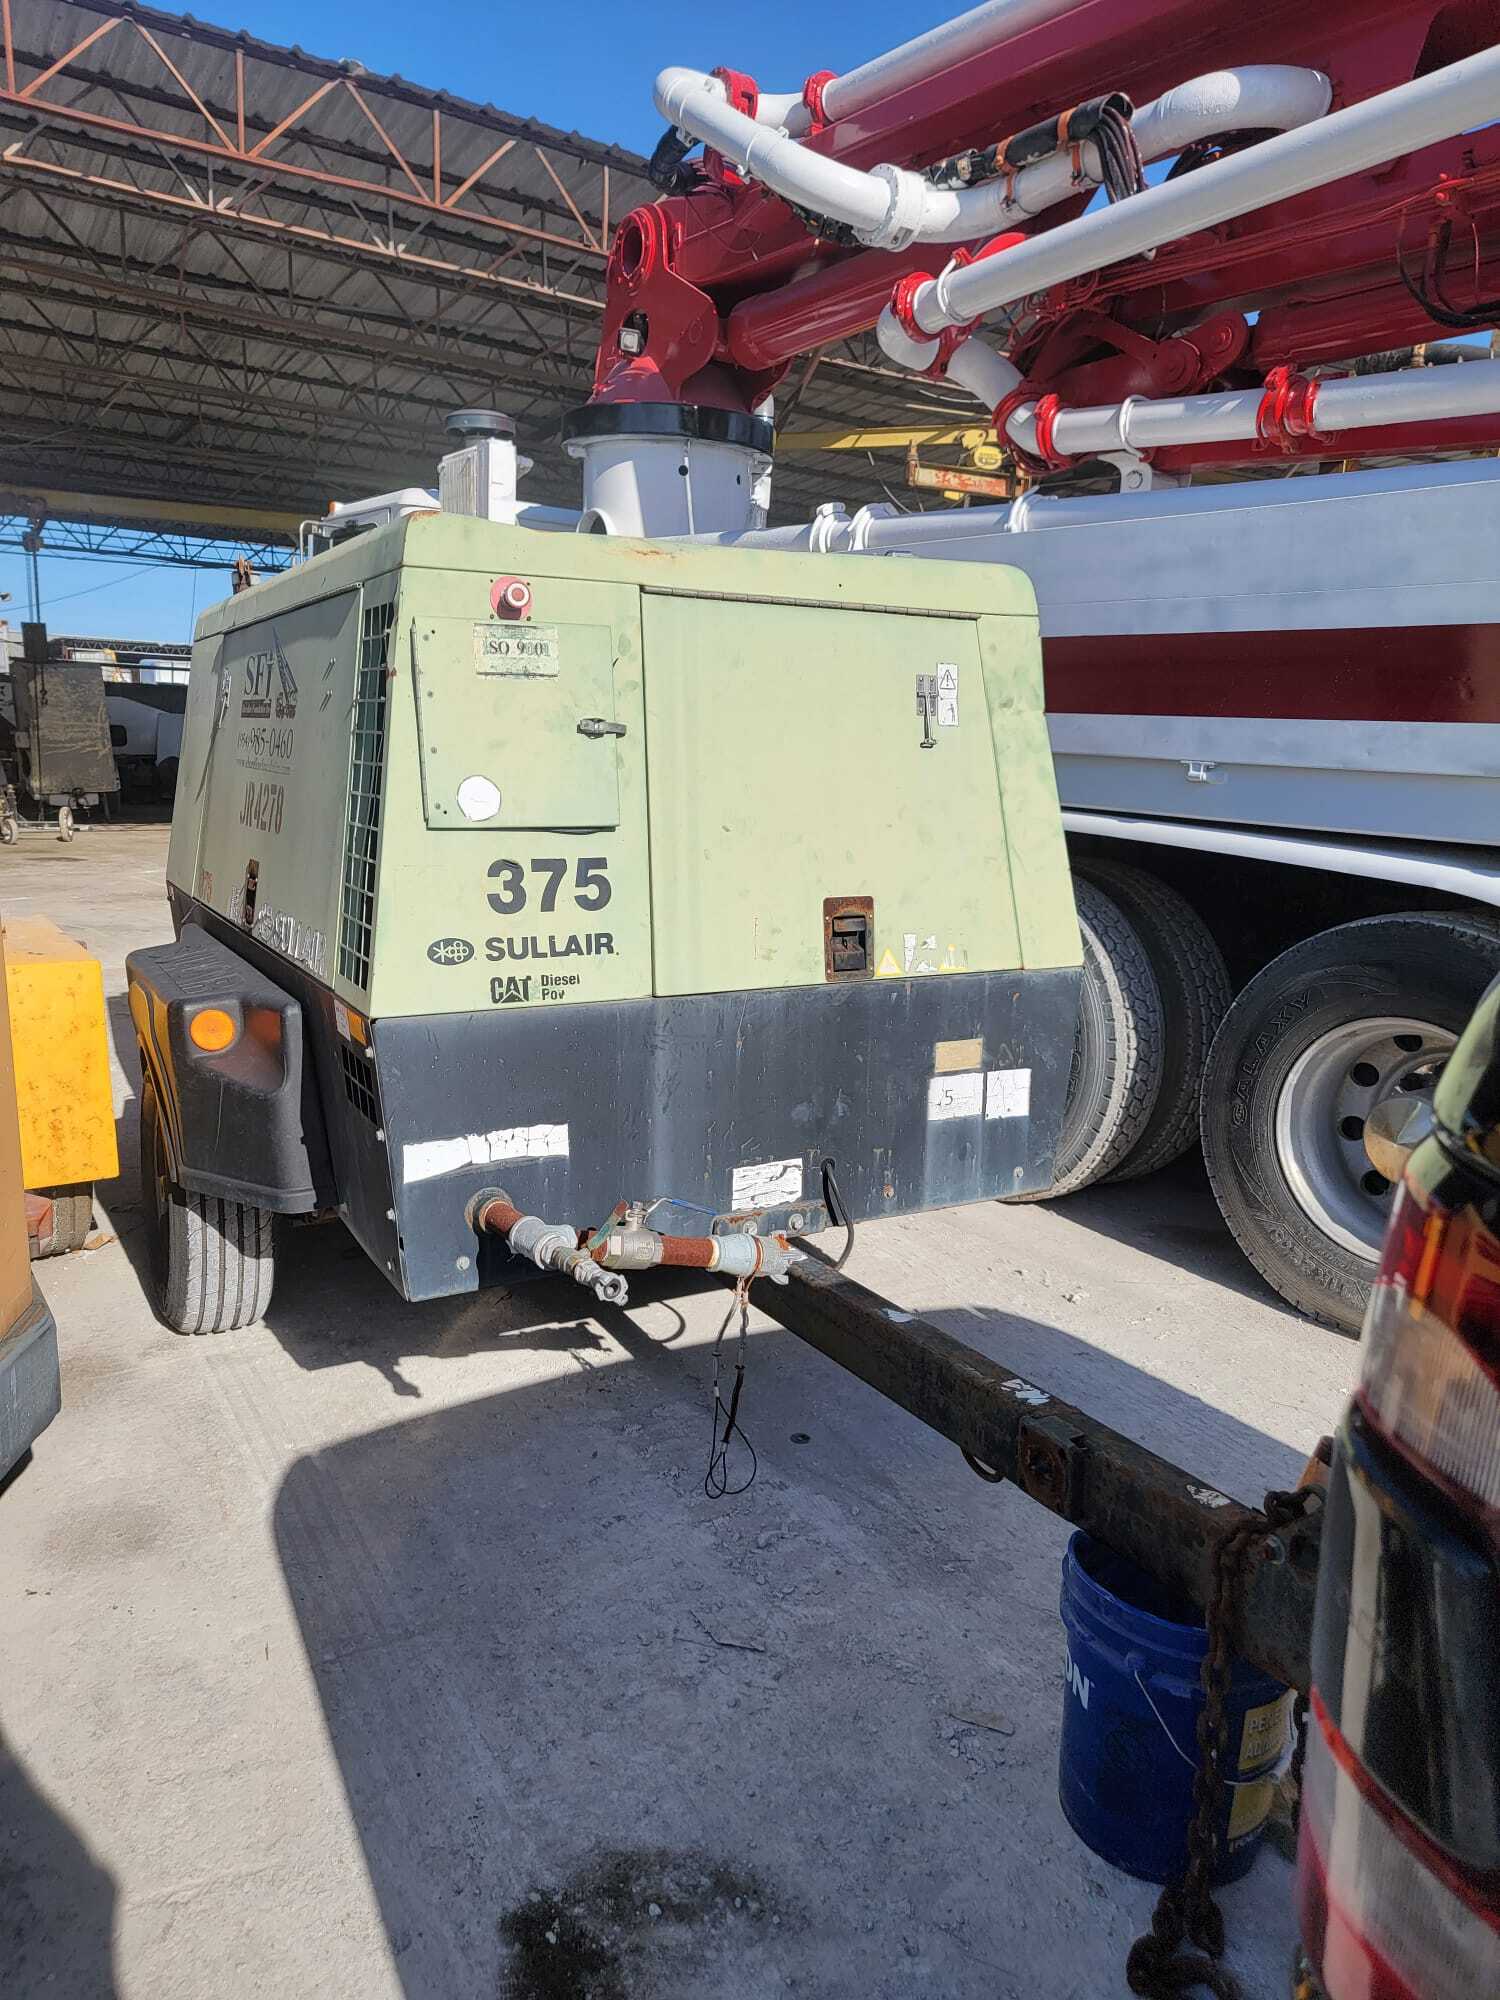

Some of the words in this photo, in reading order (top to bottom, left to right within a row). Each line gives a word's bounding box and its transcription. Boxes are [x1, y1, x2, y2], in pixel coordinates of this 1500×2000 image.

[486, 856, 612, 915] 375
[485, 932, 614, 962] SULLAIR
[490, 975, 532, 1004] CAT
[541, 973, 581, 986] Diesel
[1232, 990, 1311, 1129] GALAXY
